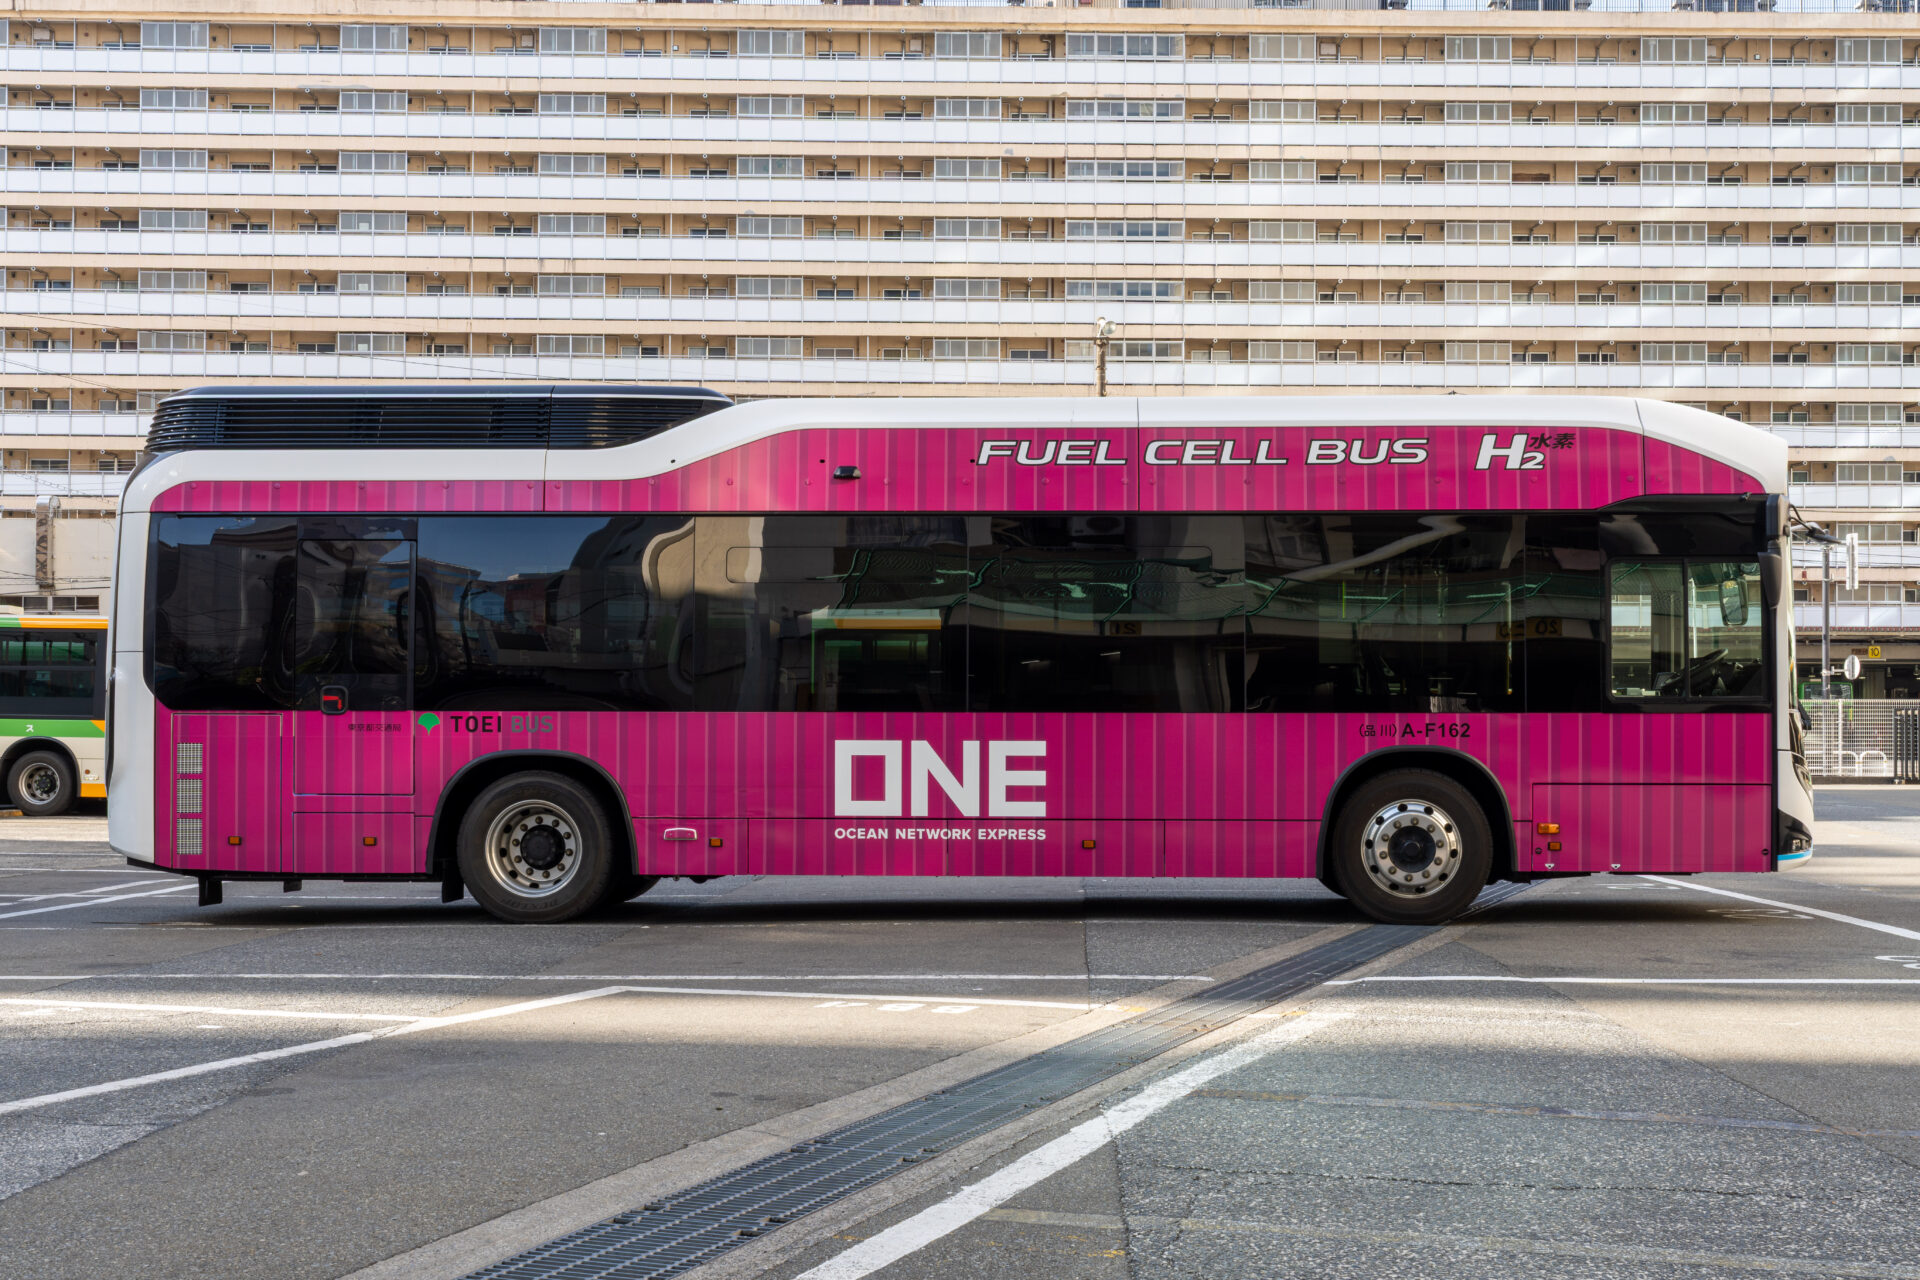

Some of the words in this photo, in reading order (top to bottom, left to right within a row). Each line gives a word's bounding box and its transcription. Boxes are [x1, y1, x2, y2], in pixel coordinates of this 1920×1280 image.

[1528, 433, 1576, 449] 水素
[976, 439, 1127, 465] FUEL
[1144, 439, 1289, 465] CELL
[1305, 438, 1430, 465] BUS
[1870, 647, 1880, 657] 10
[450, 715, 502, 733] TOEI
[511, 715, 553, 733] BUS
[1401, 722, 1471, 738] A-F162
[834, 740, 1046, 817] ONE
[834, 827, 889, 840] OCEAN
[895, 828, 972, 840] NETWORK
[977, 828, 1047, 840] EXPRESS
